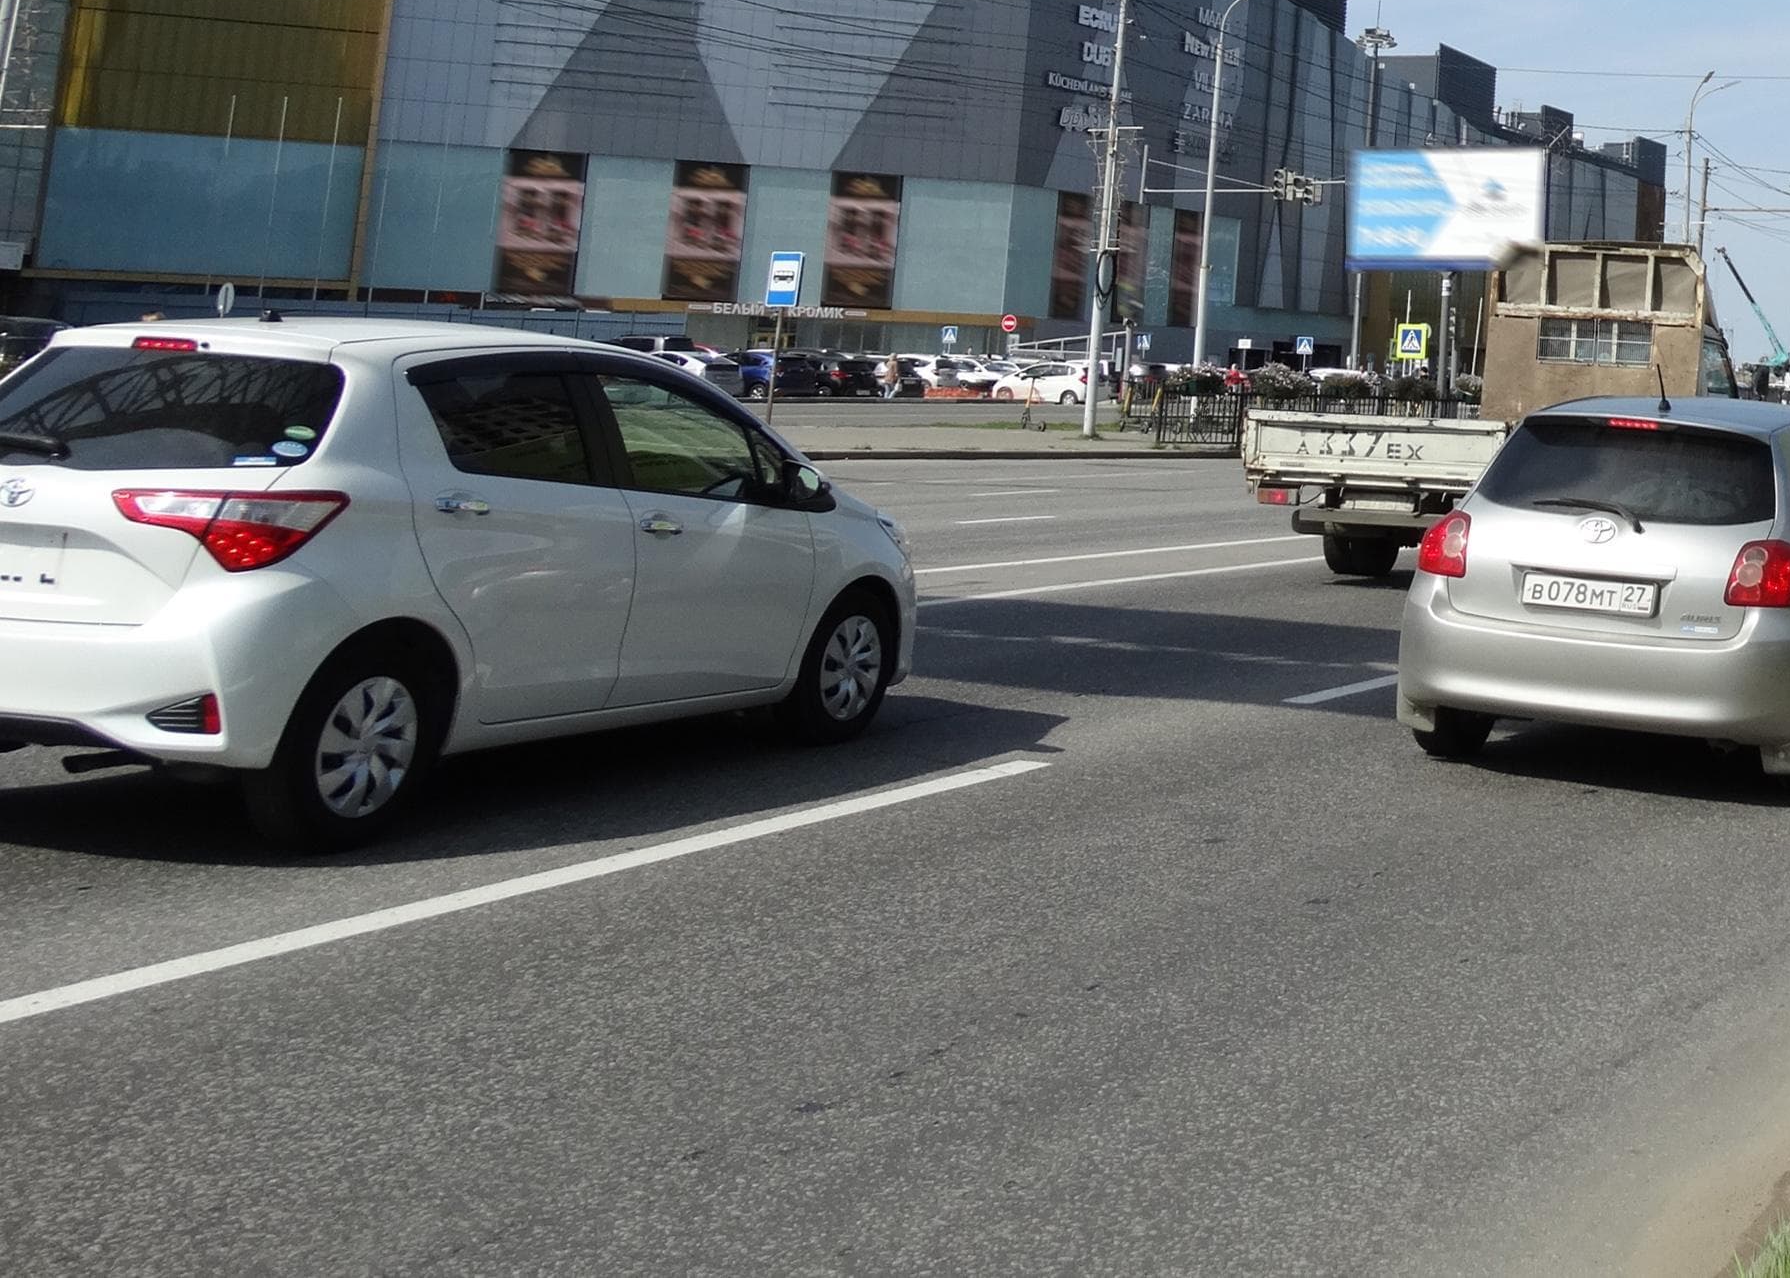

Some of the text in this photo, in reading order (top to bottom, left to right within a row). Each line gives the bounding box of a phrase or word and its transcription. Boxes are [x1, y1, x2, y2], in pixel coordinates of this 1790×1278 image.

[713, 302, 844, 319] БЕЛЫЙ КРОЛИК
[1624, 585, 1646, 602] 27
